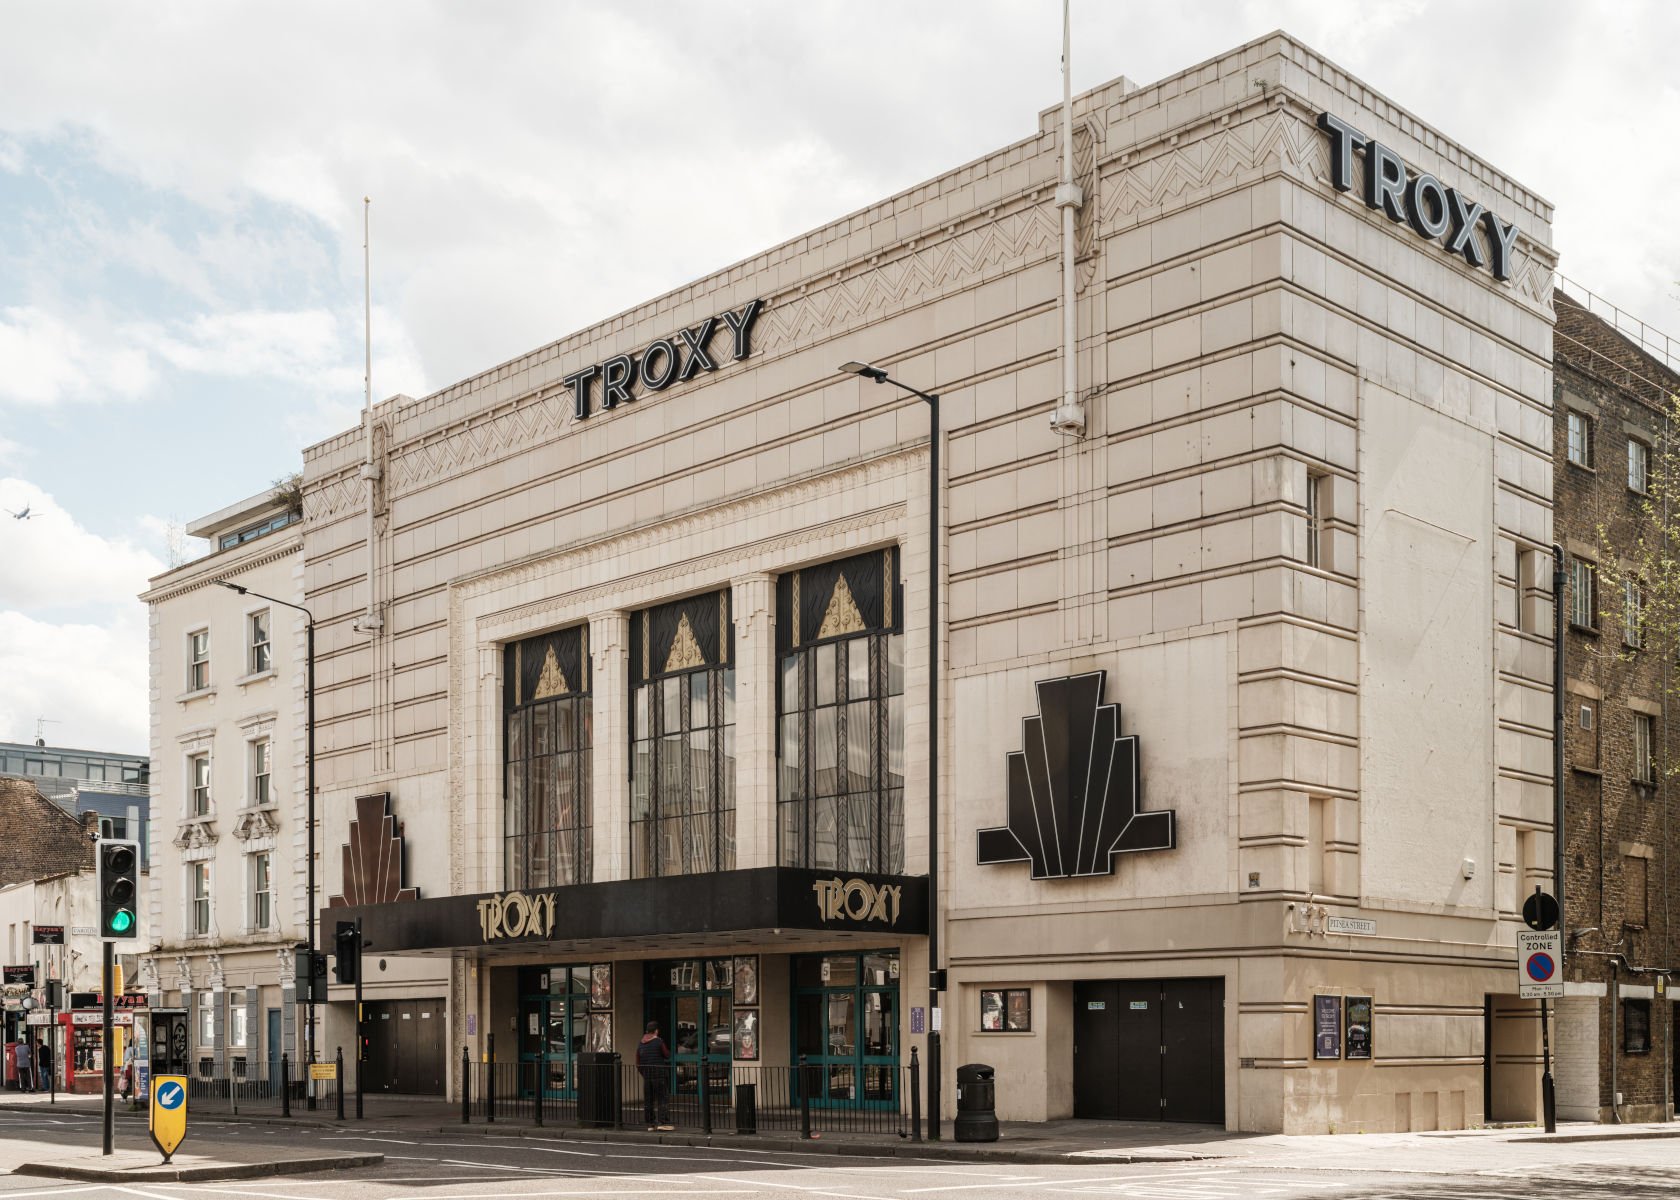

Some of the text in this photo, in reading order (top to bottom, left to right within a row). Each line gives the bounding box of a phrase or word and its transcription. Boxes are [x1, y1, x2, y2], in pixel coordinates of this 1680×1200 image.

[1317, 112, 1519, 281] TROXY
[563, 299, 764, 420] TROXY
[476, 892, 558, 942] TROXY
[813, 877, 901, 927] TROXY
[1330, 919, 1349, 929] PITSEA
[1350, 920, 1370, 931] STREET
[1520, 933, 1558, 941] Controlled
[1526, 942, 1553, 951] ZONE
